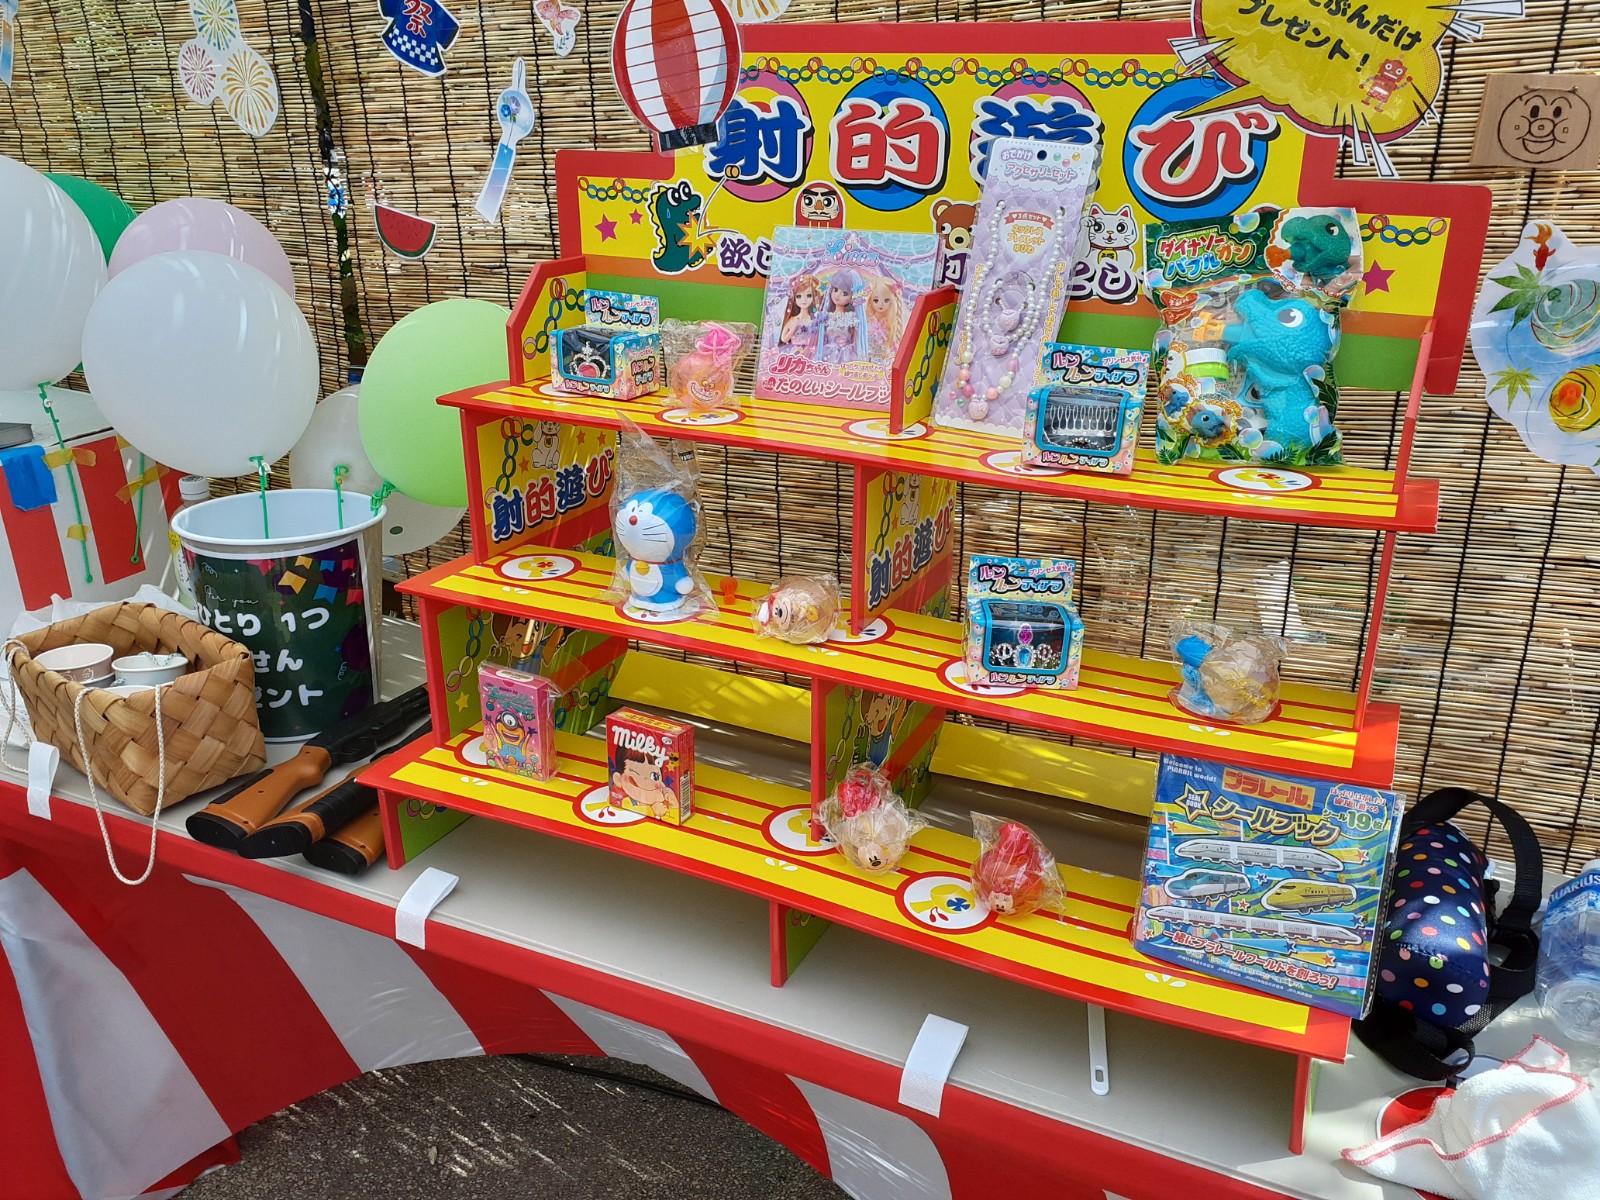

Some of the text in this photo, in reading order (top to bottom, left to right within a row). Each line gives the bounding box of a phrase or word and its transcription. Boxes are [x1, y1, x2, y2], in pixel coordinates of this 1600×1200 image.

[1308, 0, 1422, 51] ぶんだけ
[1001, 147, 1034, 160] おでかけ
[1005, 162, 1077, 183] アクセサリーセット
[825, 239, 880, 267] Licca
[1160, 232, 1226, 259] ダイナソー
[771, 356, 831, 376] リカちゃん
[1064, 365, 1139, 384] ルンティアラ
[492, 448, 613, 540] 射的遊び
[868, 498, 954, 608] 射的遊び
[990, 577, 1064, 593] ルンティアラ
[1188, 793, 1202, 802] SEAL
[1222, 769, 1309, 807] プラレール
[1185, 800, 1202, 809] BOOK
[1210, 796, 1341, 845] シールブック
